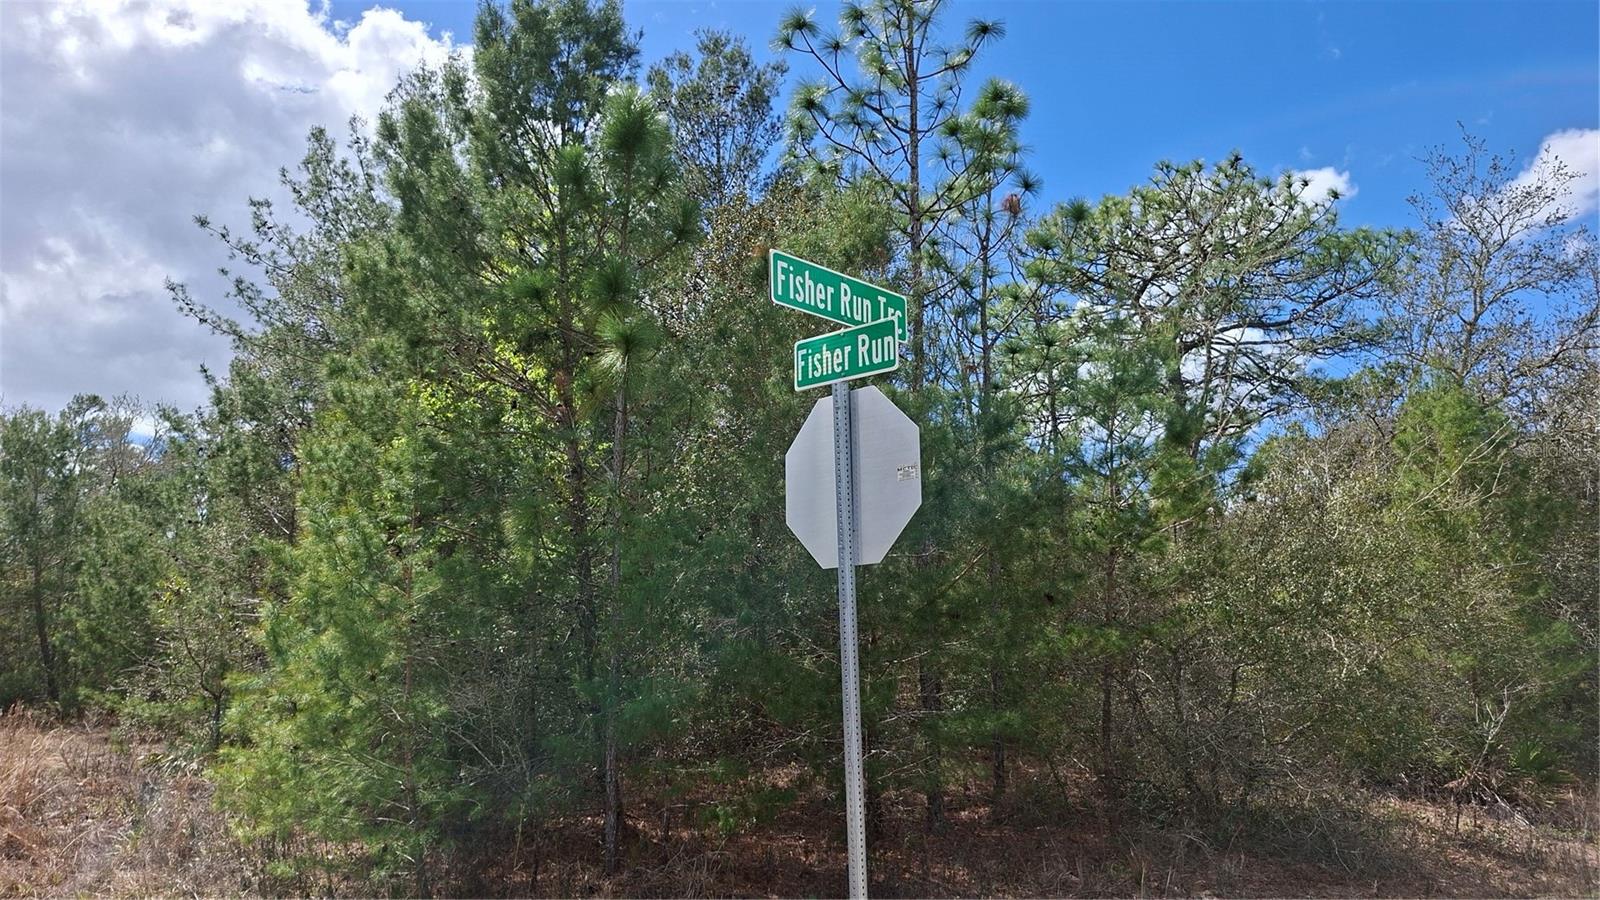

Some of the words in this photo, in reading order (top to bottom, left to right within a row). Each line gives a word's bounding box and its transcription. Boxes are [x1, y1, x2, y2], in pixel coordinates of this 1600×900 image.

[777, 260, 834, 311] Fisher
[840, 282, 872, 323] Run
[797, 344, 851, 381] Fisher
[858, 334, 895, 367] Run
